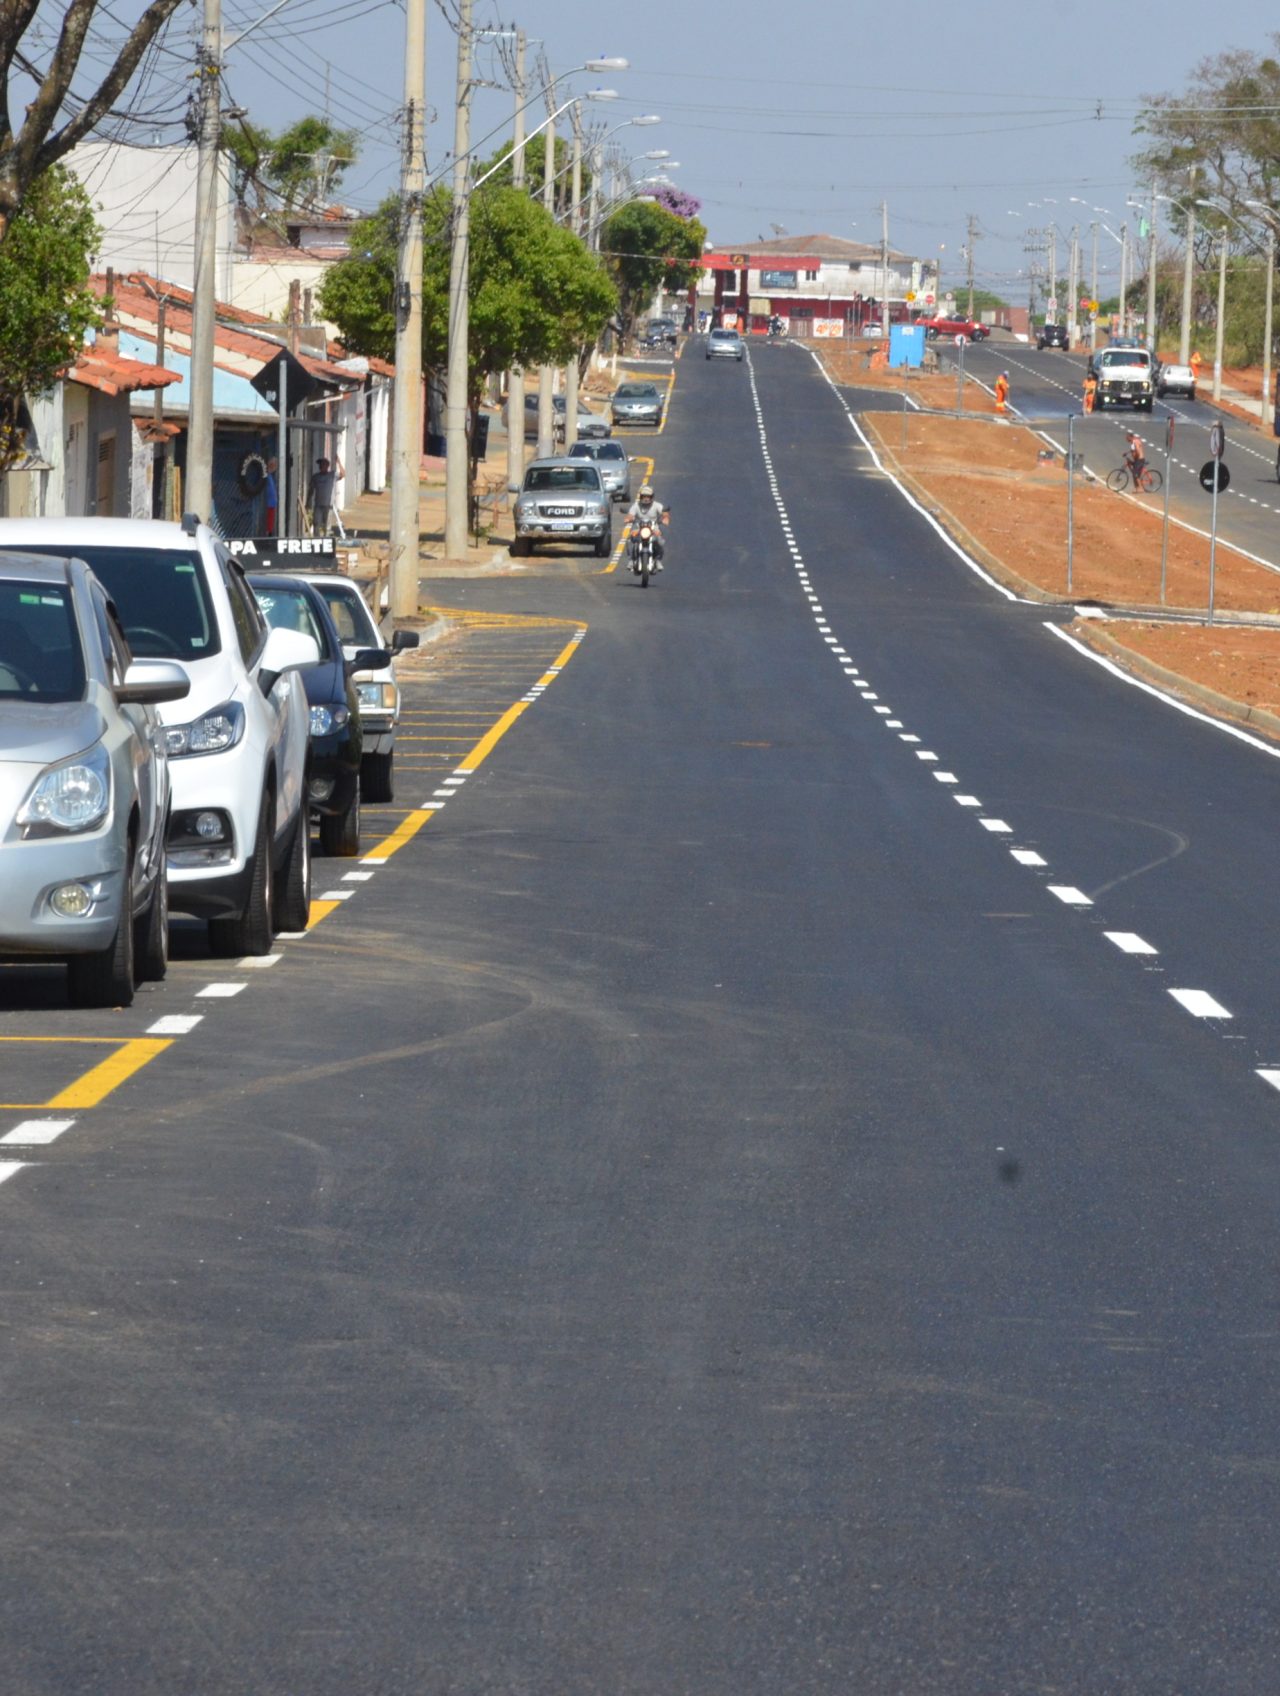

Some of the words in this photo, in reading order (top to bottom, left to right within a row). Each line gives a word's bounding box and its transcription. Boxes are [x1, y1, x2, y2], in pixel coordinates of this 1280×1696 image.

[547, 507, 575, 516] FORD
[224, 540, 257, 555] PA
[277, 539, 333, 553] FRETE
